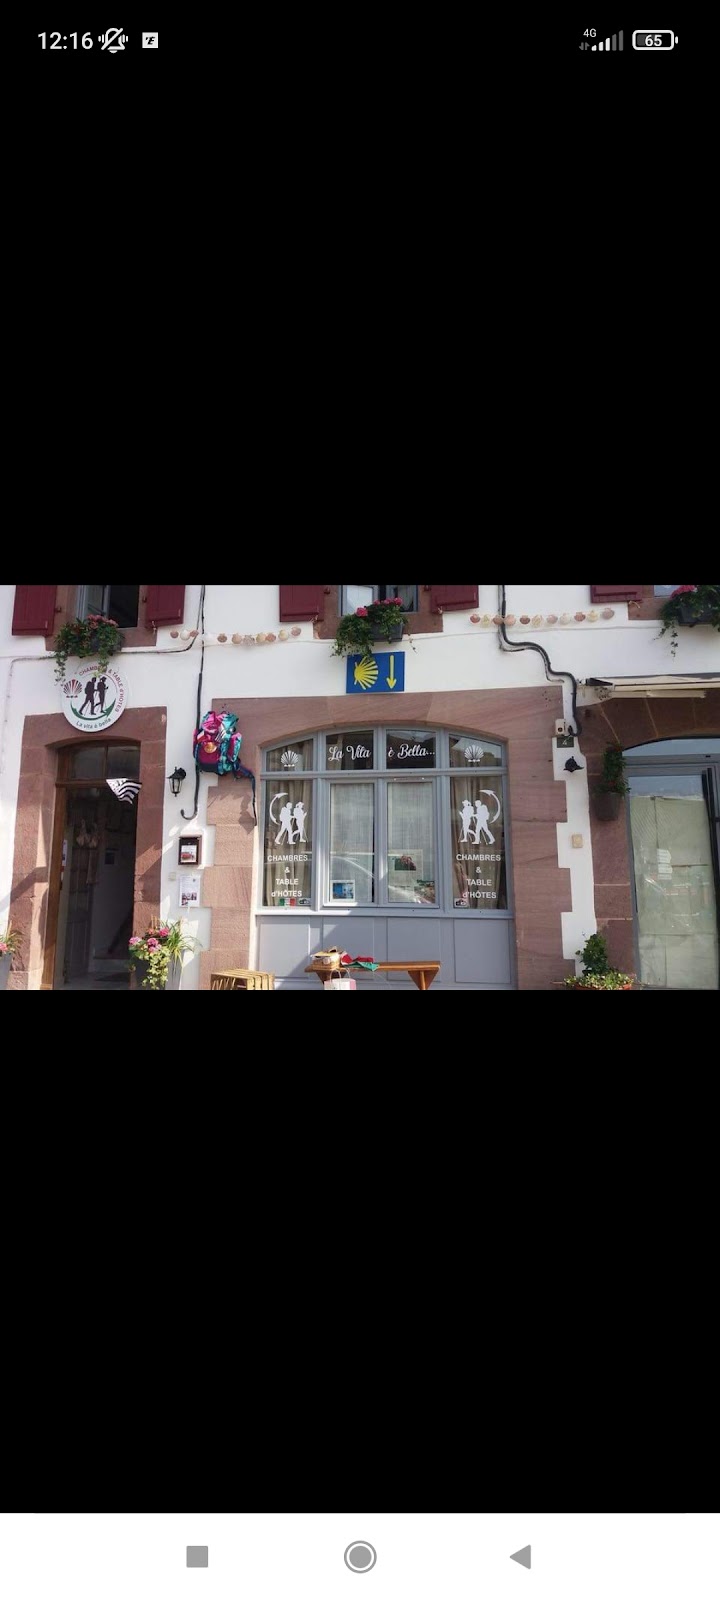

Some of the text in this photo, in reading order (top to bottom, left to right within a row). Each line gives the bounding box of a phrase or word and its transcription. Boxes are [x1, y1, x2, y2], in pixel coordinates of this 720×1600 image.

[113, 671, 123, 687] TABLE
[328, 746, 344, 761] La
[346, 745, 372, 760] Vita
[267, 854, 308, 862] CHAMBRES
[456, 853, 501, 861] CHAMBRES
[466, 878, 492, 886] TABLE
[271, 889, 303, 897] d'HÔTES
[462, 890, 497, 899] d'HÔTES
